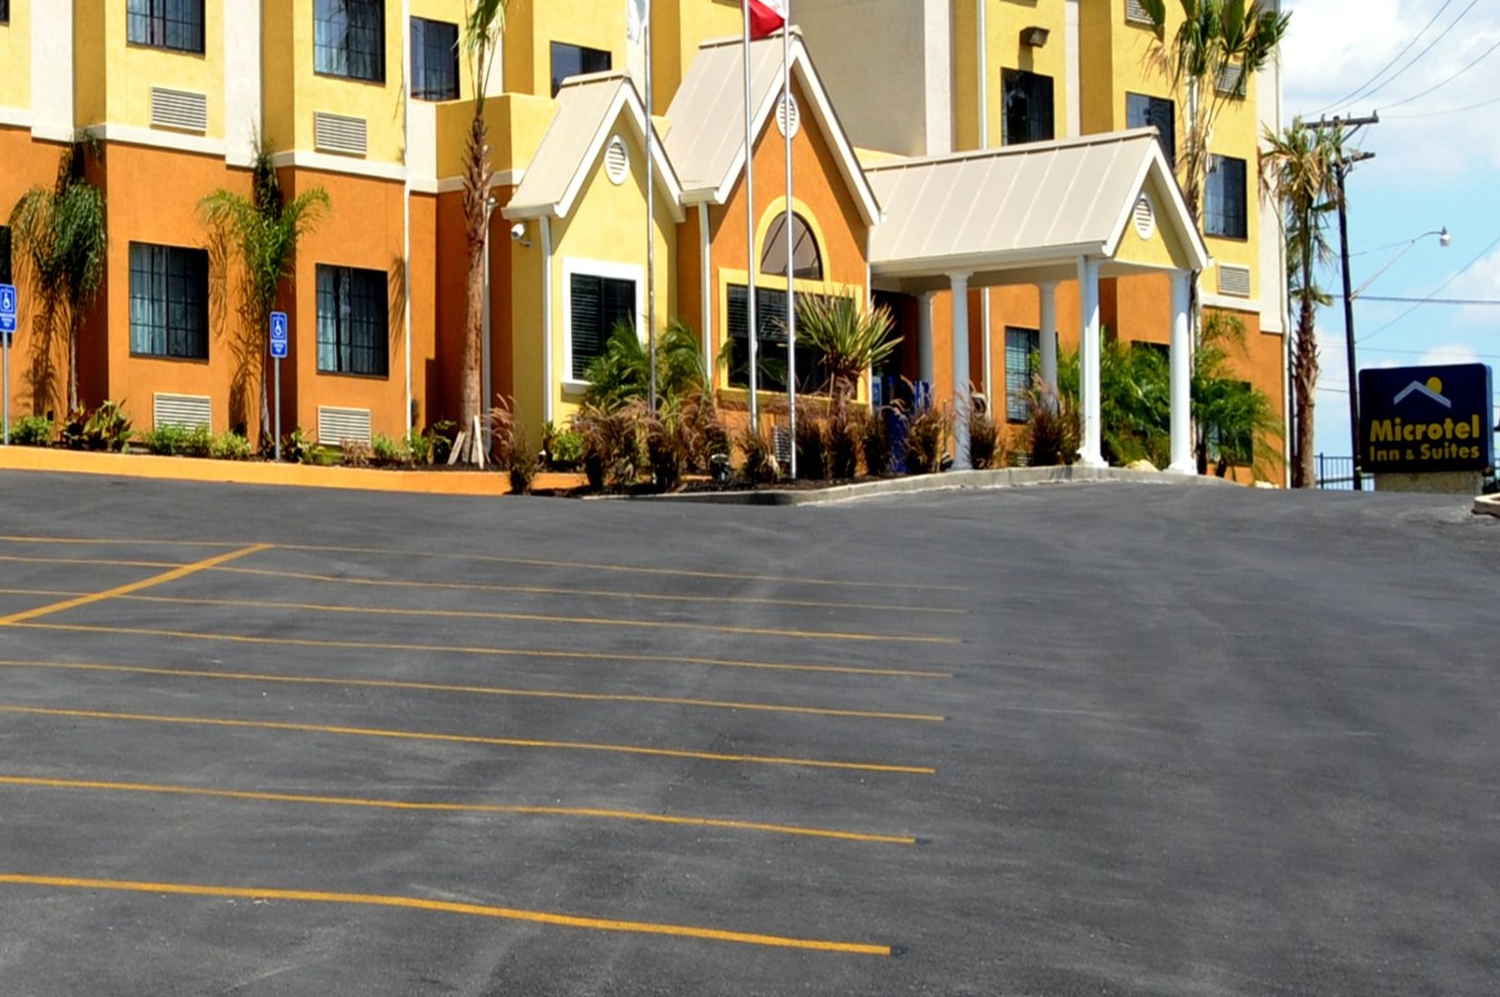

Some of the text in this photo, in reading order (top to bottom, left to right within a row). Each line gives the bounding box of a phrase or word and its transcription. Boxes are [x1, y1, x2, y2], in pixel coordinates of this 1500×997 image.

[1369, 413, 1480, 442] Microtel
[1369, 441, 1480, 462] Inn & Suites
